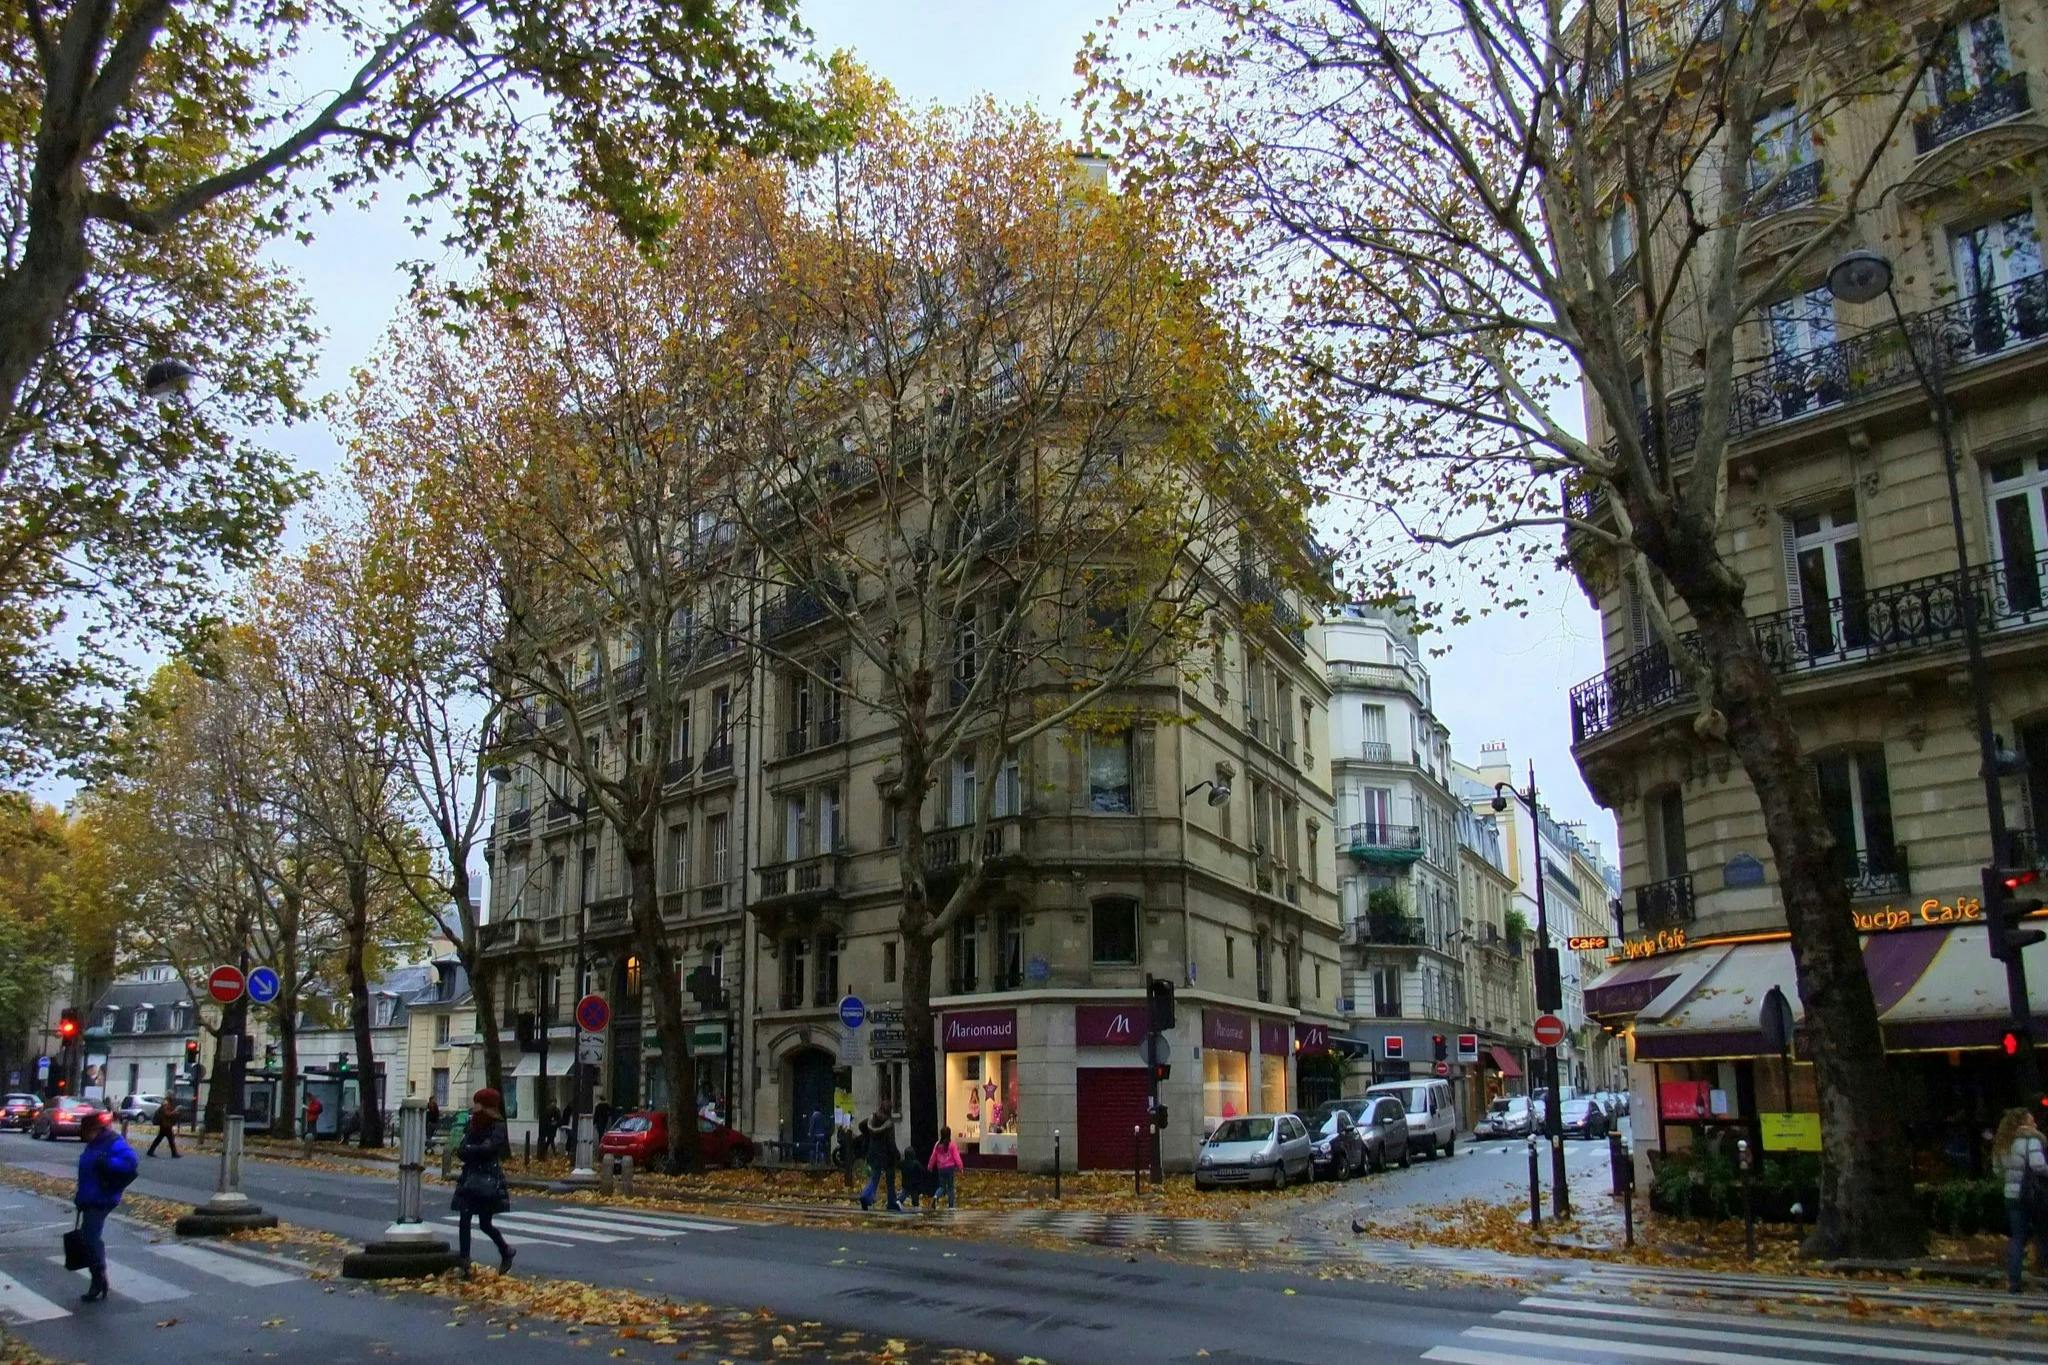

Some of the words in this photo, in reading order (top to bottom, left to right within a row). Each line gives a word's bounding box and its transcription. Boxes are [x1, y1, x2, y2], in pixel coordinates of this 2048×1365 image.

[1920, 896, 1980, 923] Café
[1624, 935, 1656, 959] Mucha
[1658, 928, 1686, 951] Café
[945, 1019, 1012, 1042] Marionnaud
[1105, 1013, 1131, 1039] M
[1302, 1027, 1323, 1049] M
